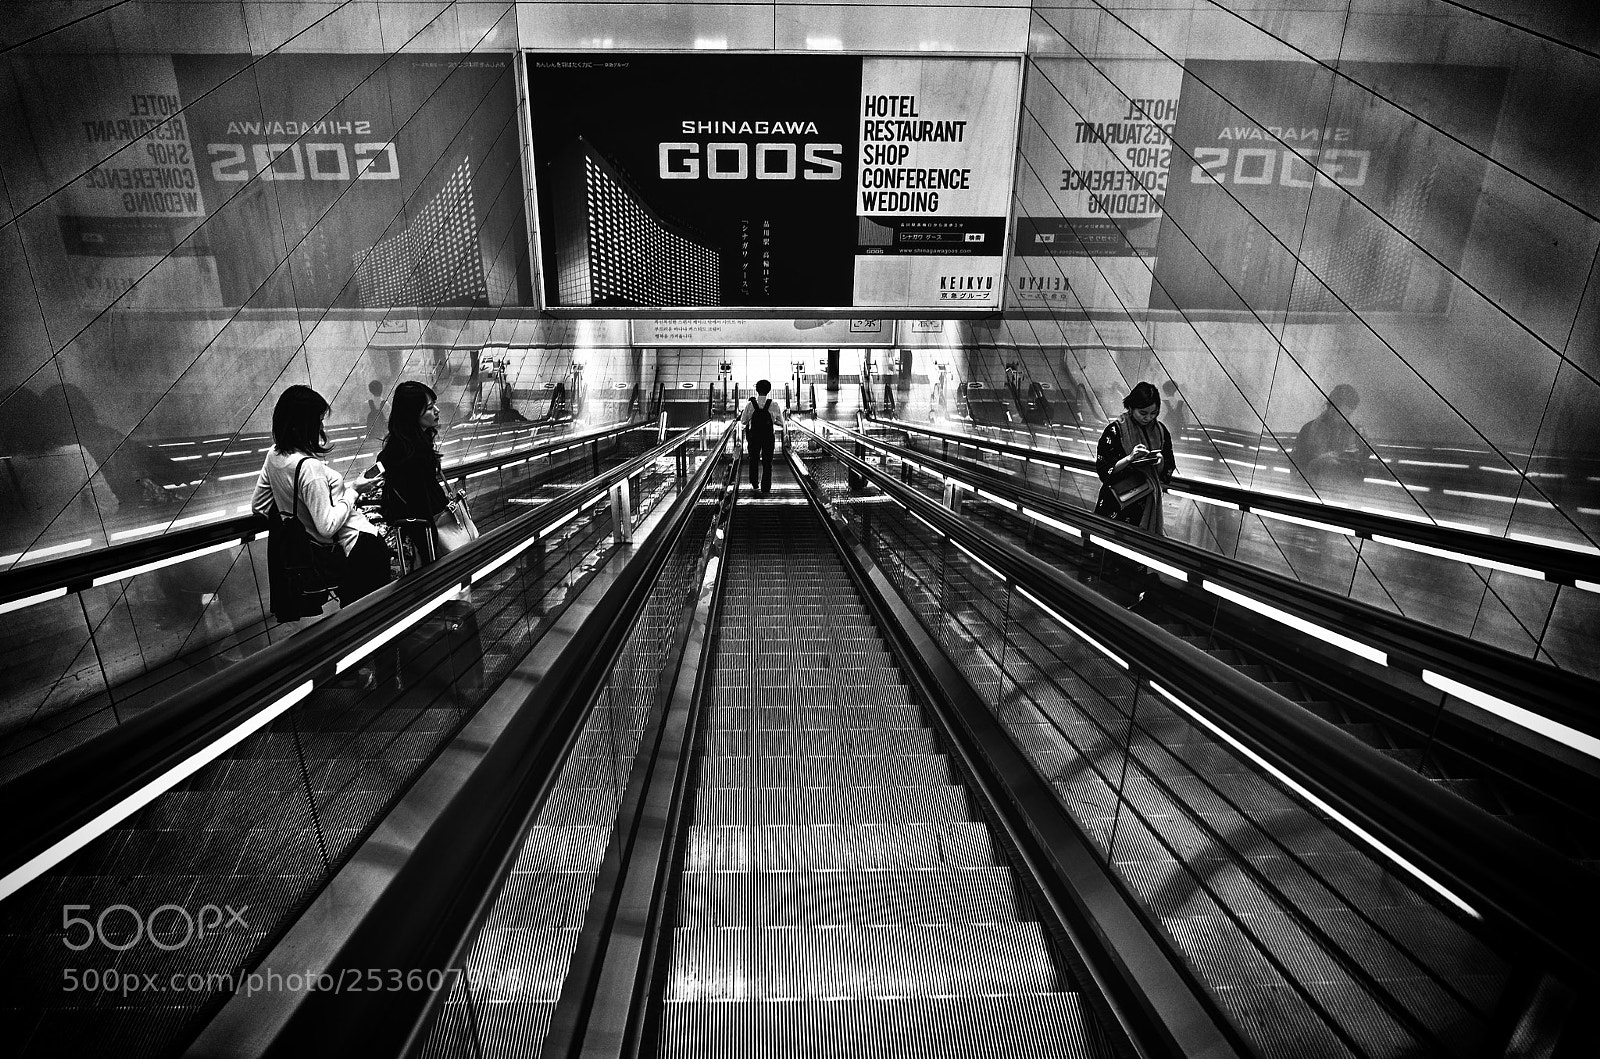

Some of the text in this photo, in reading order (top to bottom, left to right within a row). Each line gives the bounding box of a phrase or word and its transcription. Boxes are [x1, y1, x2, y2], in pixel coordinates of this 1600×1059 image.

[864, 95, 918, 118] HOTEL
[682, 120, 818, 134] SHINAGAWA
[864, 120, 966, 142] RESTAURANT
[658, 142, 843, 180] GOOS
[863, 144, 909, 166] SHOP
[862, 168, 970, 190] CONFERENCE
[862, 192, 938, 212] WEDDING
[940, 276, 992, 290] KEIKYU
